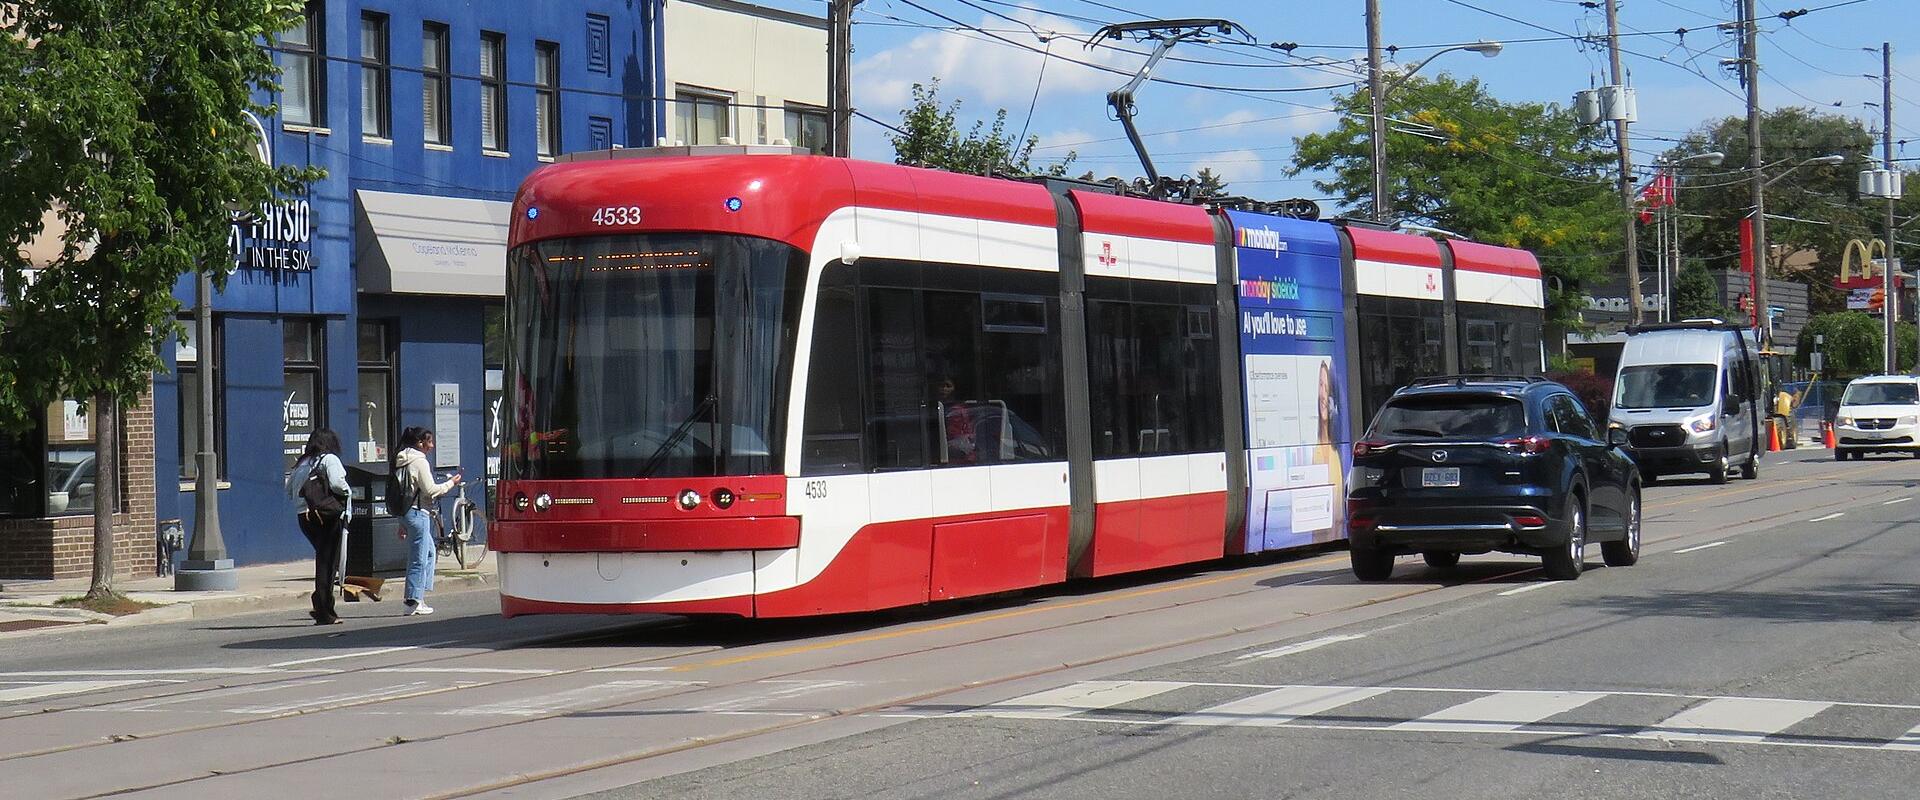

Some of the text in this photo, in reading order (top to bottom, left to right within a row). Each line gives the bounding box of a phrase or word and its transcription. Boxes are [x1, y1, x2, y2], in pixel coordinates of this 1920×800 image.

[592, 206, 641, 226] 4533
[252, 246, 310, 271] IN THE SIX
[1240, 275, 1301, 304] monday sidekick
[1271, 312, 1286, 335] love
[1286, 314, 1295, 335] to
[1295, 318, 1307, 336] use
[440, 393, 455, 406] 2794
[805, 480, 827, 499] 4533
